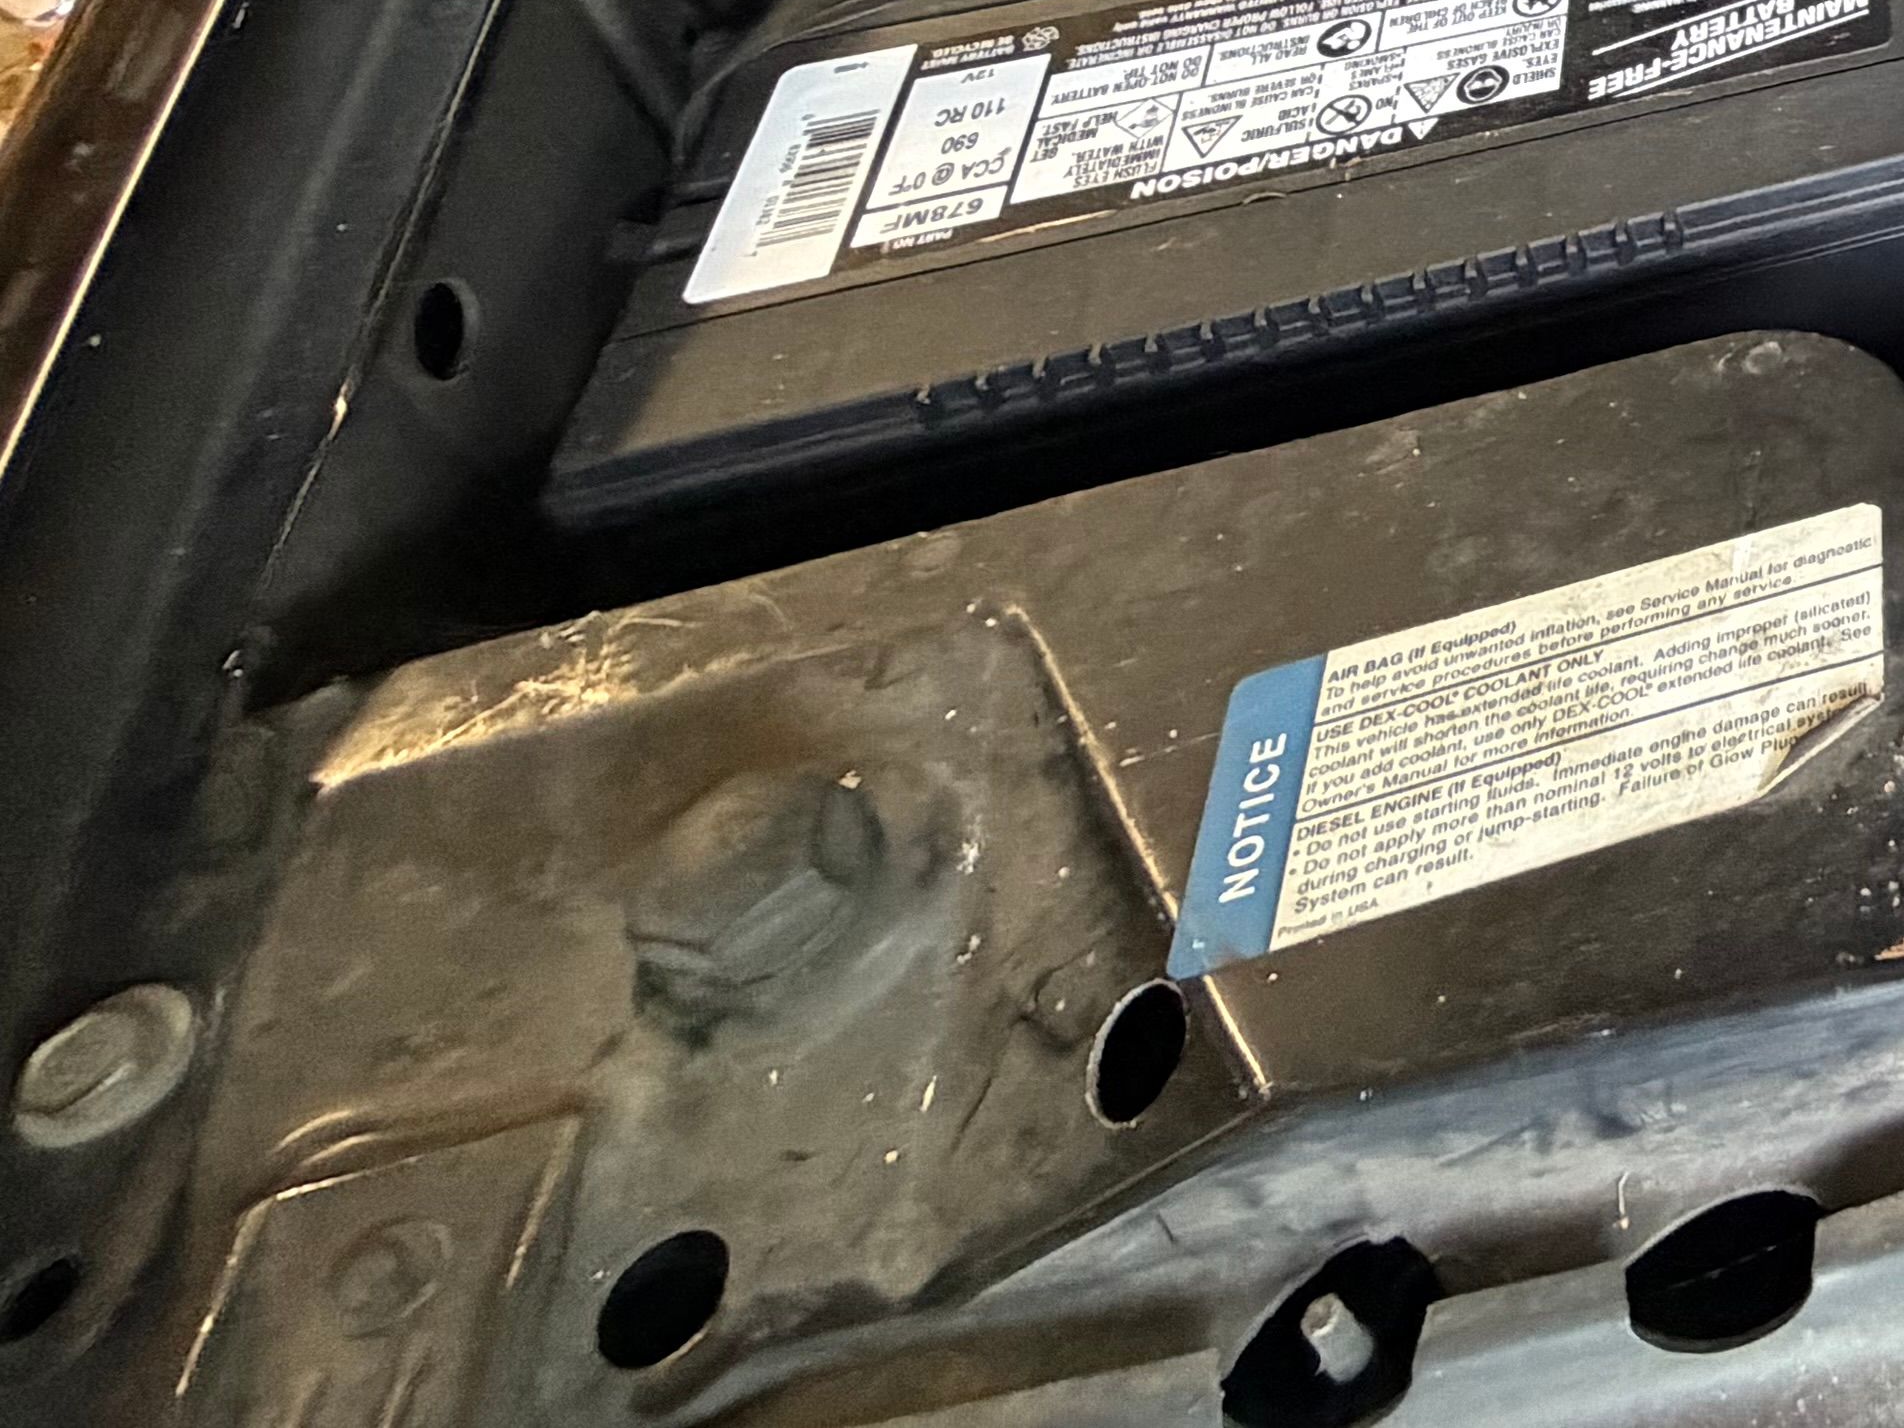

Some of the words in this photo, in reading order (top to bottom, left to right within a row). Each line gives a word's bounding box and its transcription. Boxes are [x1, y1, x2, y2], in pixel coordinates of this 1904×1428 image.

[1447, 53, 1487, 70] GASES
[1492, 38, 1559, 60] EXPLOSIVE
[960, 68, 994, 83] 12V
[934, 105, 967, 126] RC
[971, 97, 1004, 119] 110
[1240, 118, 1305, 141] SULFURIC
[1278, 105, 1309, 120] ACID
[941, 131, 978, 154] 690
[1029, 145, 1058, 162] GET
[1037, 127, 1098, 148] MEDICAL
[888, 171, 926, 195] 0°F
[931, 162, 954, 185] @
[961, 150, 1008, 179] CCA
[1063, 148, 1160, 177] IMMEDIATELY
[1131, 128, 1401, 197] DANGER/POISON
[880, 198, 982, 233] 678MF
[1326, 686, 1344, 699] To
[1350, 674, 1386, 693] help
[1391, 657, 1438, 680] avoid
[1444, 633, 1524, 666] unwanted
[1530, 613, 1601, 641] inflation,
[1606, 604, 1634, 620] see
[1640, 586, 1699, 610] Service
[1705, 565, 1762, 592] Manual
[1767, 561, 1788, 575] for
[1790, 537, 1871, 567] diagnostic
[1314, 741, 1349, 760] This
[1356, 721, 1417, 747] vehicle
[1547, 676, 1572, 692] life
[1653, 637, 1710, 661] Adding
[1716, 614, 1787, 643] improper
[1794, 590, 1870, 623] (silicated)
[1321, 696, 1354, 716] and
[1361, 679, 1425, 704] service
[1432, 648, 1530, 686] procedures
[1538, 631, 1593, 654] before
[1600, 604, 1690, 638] performing
[1697, 592, 1726, 609] any
[1327, 664, 1358, 683] AIR
[1363, 652, 1402, 673] BAG
[1407, 645, 1425, 662] (If
[1431, 620, 1515, 654] Equipped)
[1305, 780, 1317, 795] If
[1323, 772, 1354, 791] you
[1360, 758, 1393, 779] add
[1398, 739, 1466, 768] coolant,
[1473, 727, 1504, 745] use
[1510, 715, 1546, 734] only
[1734, 654, 1761, 674] life
[1838, 625, 1871, 641] See
[1309, 748, 1373, 778] coolant
[1379, 737, 1408, 756] will
[1413, 720, 1478, 747] shorten
[1484, 710, 1511, 726] the
[1516, 688, 1581, 716] coolant
[1620, 658, 1693, 686] requiring
[1698, 640, 1758, 664] change
[1763, 625, 1806, 646] much
[1813, 610, 1870, 632] sooner.
[1316, 721, 1353, 742] USE
[1463, 664, 1550, 700] COOLANT
[1556, 649, 1603, 672] ONLY
[1302, 783, 1374, 812] Owner's
[1382, 759, 1447, 788] Manual
[1454, 751, 1477, 767] for
[1483, 738, 1527, 758] more
[1534, 708, 1632, 743] information.
[1306, 839, 1332, 855] Do
[1337, 826, 1367, 847] not
[1373, 816, 1406, 835] use
[1413, 794, 1479, 823] starting
[1487, 777, 1539, 801] fluids.
[1553, 746, 1642, 780] Immediate
[1649, 727, 1706, 754] engine
[1712, 706, 1779, 736] damage
[1786, 691, 1819, 713] can
[1218, 732, 1287, 904] NOTICE
[1296, 811, 1364, 841] DIESEL
[1370, 786, 1442, 818] ENGINE
[1447, 779, 1465, 797] (If
[1471, 748, 1566, 788] Equipped)
[1303, 857, 1329, 874] Do
[1336, 844, 1367, 864] not
[1373, 827, 1425, 852] apply
[1431, 812, 1478, 835] more
[1486, 797, 1526, 818] than
[1533, 771, 1605, 804] nominal
[1614, 763, 1633, 784] 12
[1640, 751, 1681, 777] volts
[1687, 742, 1707, 761] to
[1711, 718, 1790, 756] electrical
[1297, 866, 1357, 894] during
[1364, 839, 1446, 872] charging
[1453, 830, 1473, 846] or
[1477, 792, 1605, 841] jump-starting.
[1618, 768, 1679, 796] Failure
[1686, 759, 1703, 780] of
[1294, 882, 1365, 913] System
[1373, 869, 1408, 888] can
[1415, 848, 1473, 875] result.
